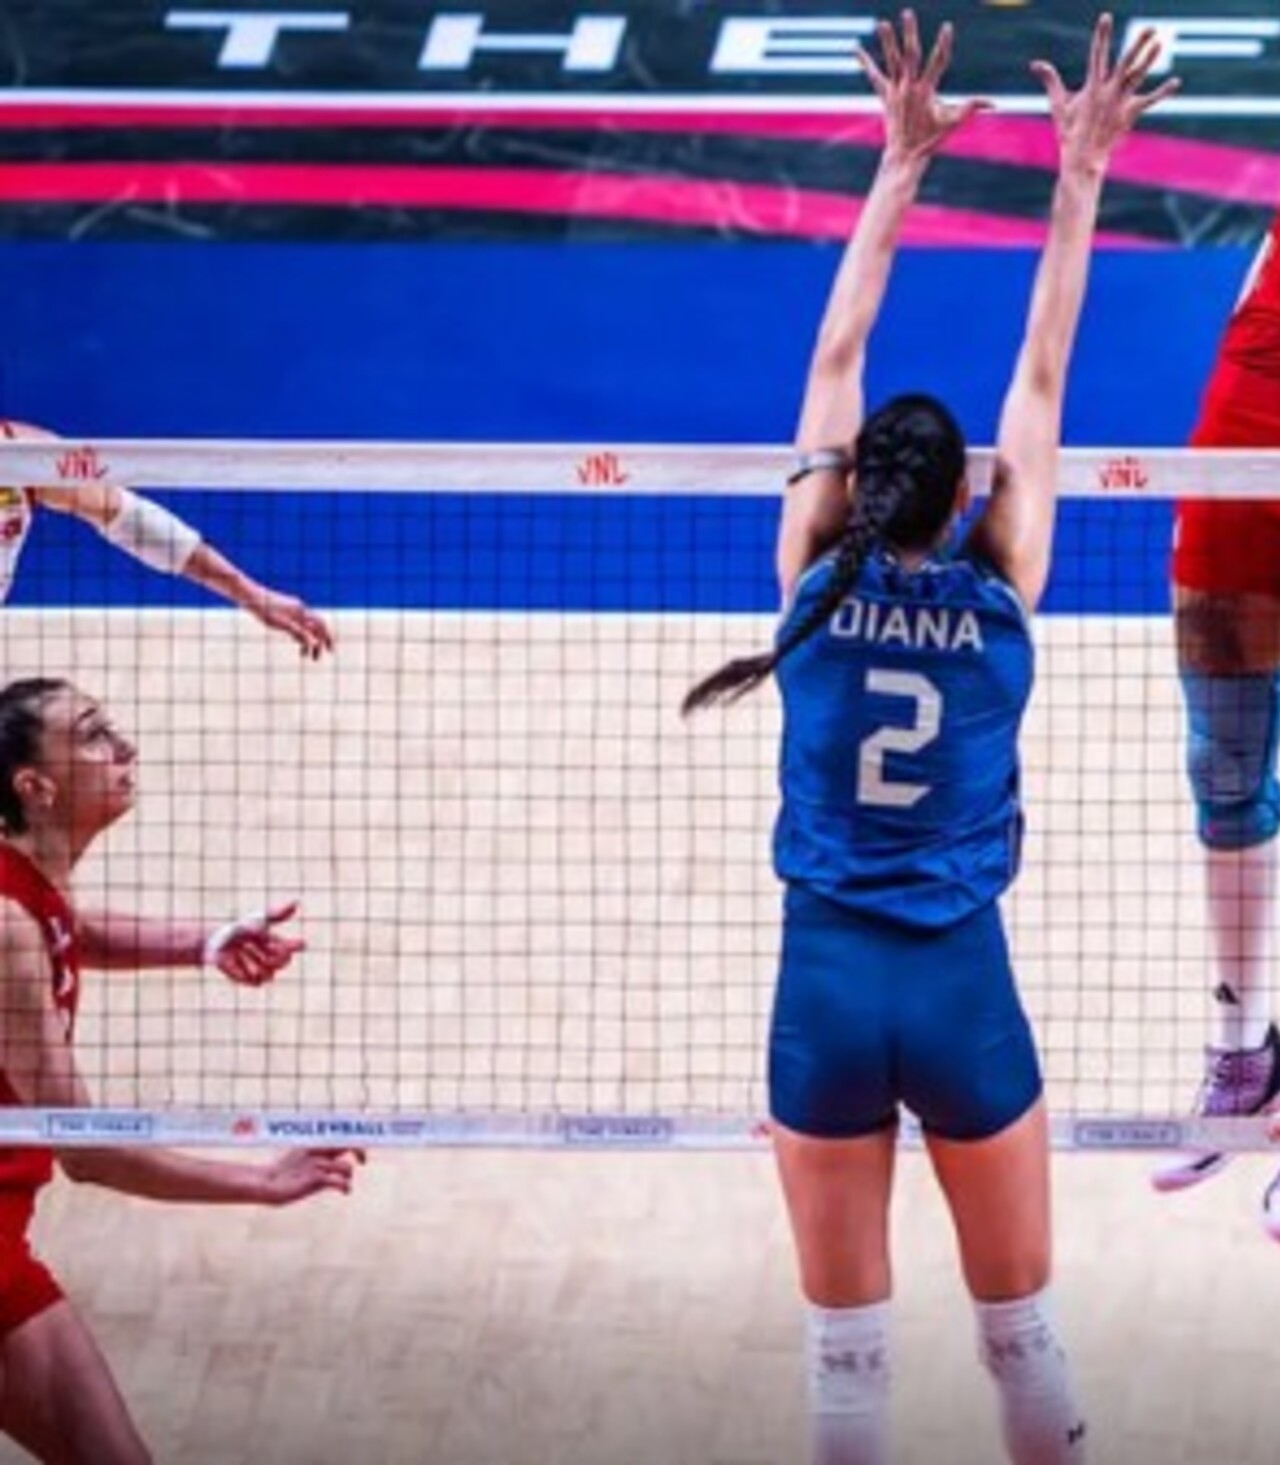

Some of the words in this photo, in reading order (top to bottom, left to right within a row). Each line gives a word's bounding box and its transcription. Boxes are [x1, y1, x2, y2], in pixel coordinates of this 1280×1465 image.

[165, 10, 878, 73] THE
[828, 598, 985, 653] DIANA
[856, 667, 944, 808] 2
[267, 1119, 385, 1137] VOLLEYBALL
